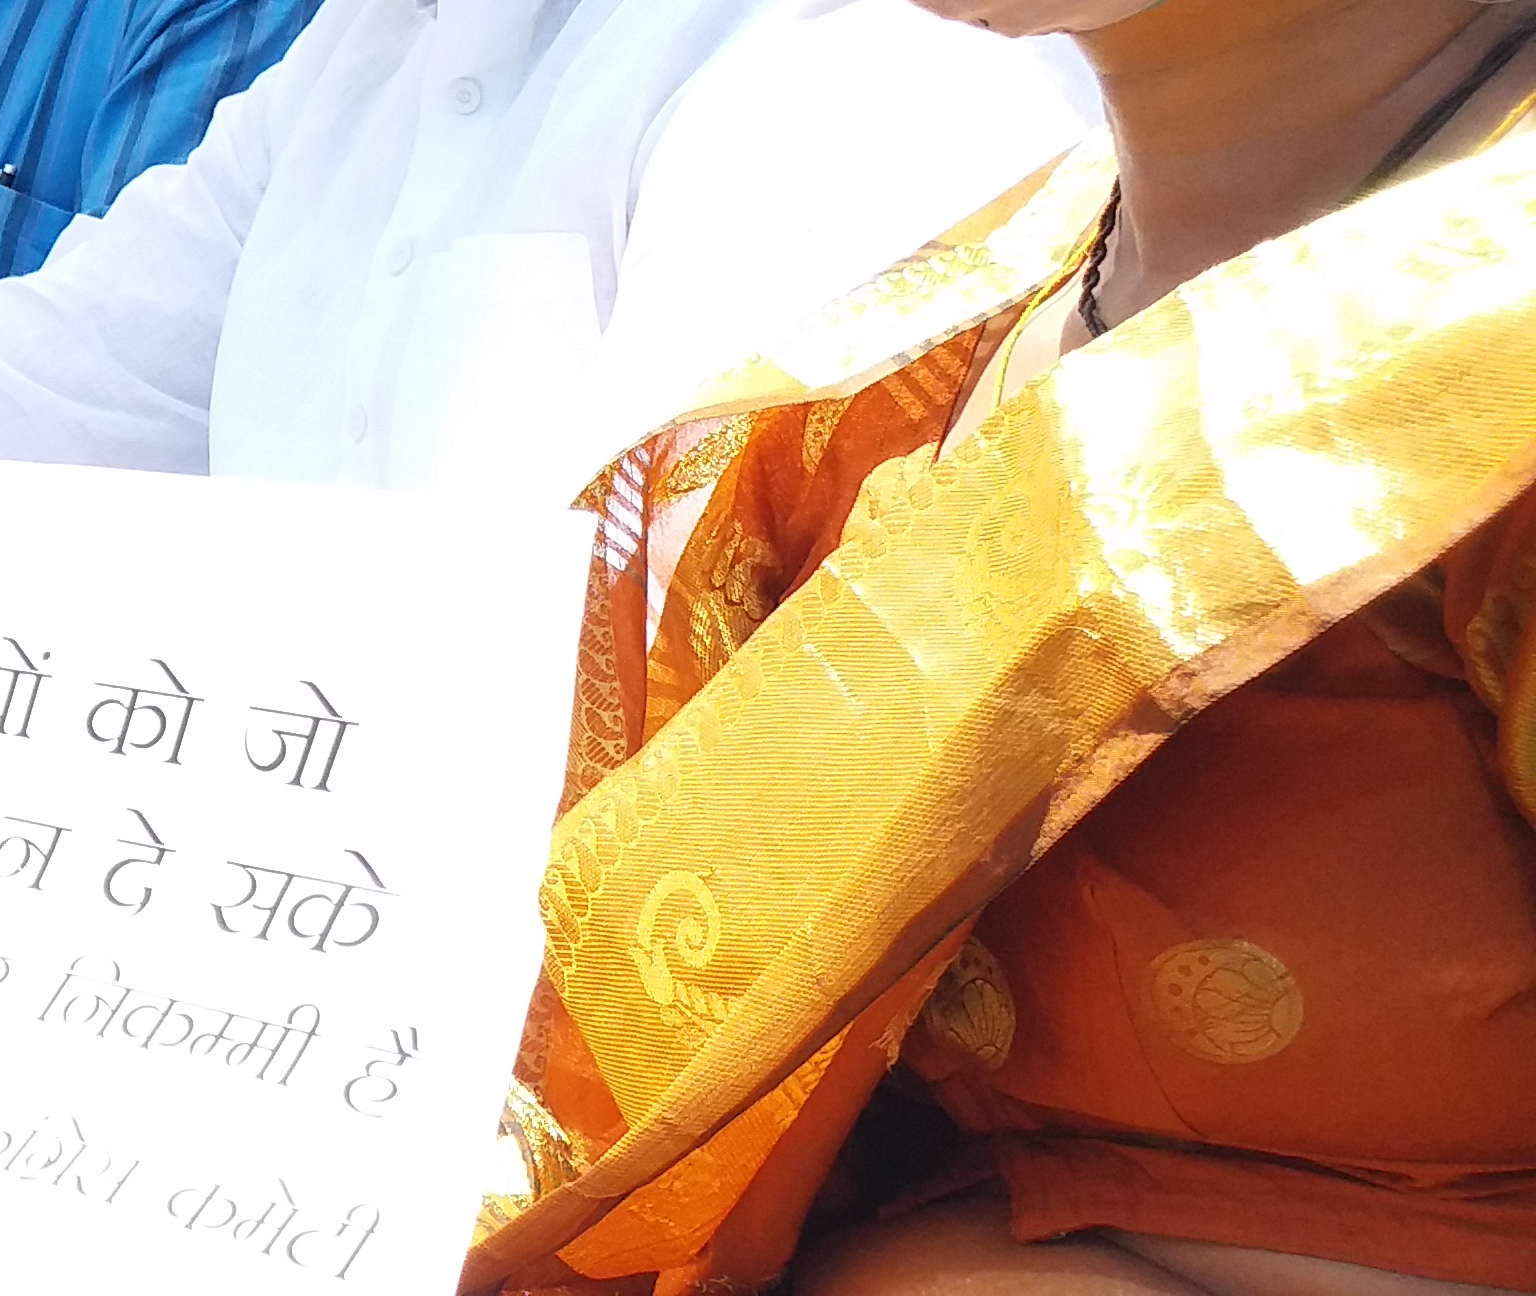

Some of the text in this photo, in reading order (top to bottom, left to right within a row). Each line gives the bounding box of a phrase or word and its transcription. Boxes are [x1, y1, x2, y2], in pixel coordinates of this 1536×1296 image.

[86, 659, 204, 766] को
[243, 681, 359, 792] जो
[103, 808, 177, 915] दे
[211, 849, 402, 955] सके
[36, 954, 324, 1089] निकम्मी
[343, 1025, 421, 1118] है
[165, 1177, 381, 1282] कमेटी
